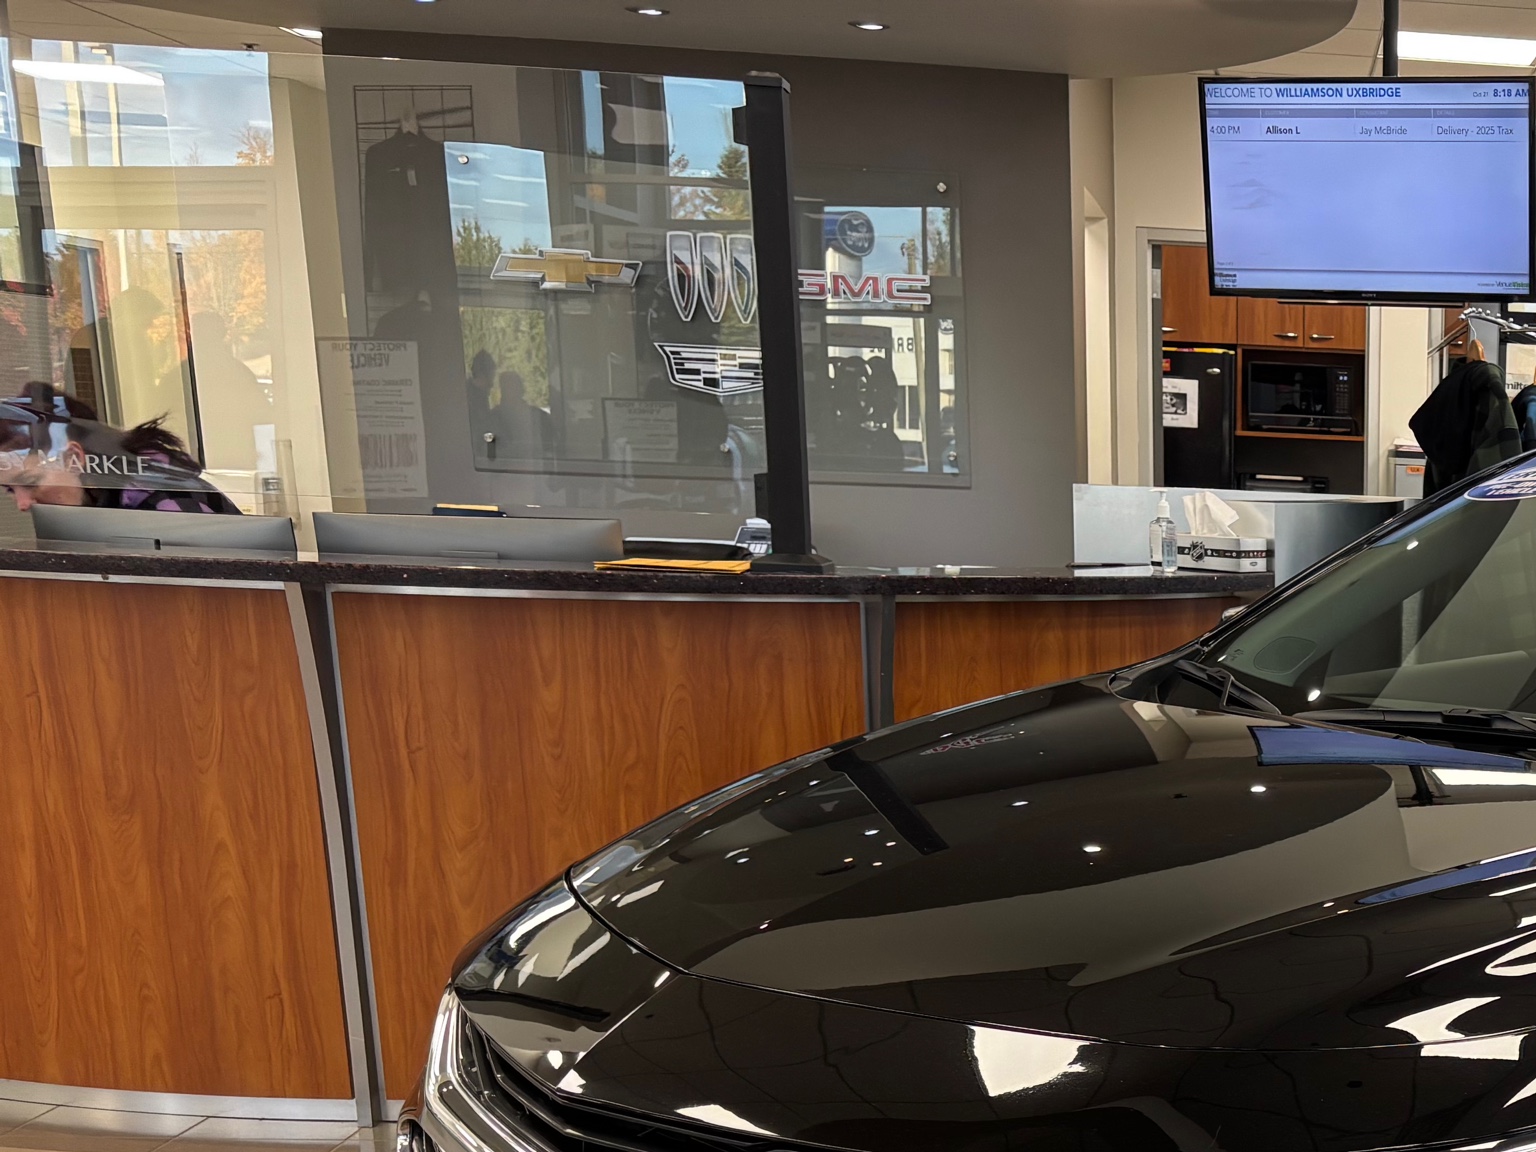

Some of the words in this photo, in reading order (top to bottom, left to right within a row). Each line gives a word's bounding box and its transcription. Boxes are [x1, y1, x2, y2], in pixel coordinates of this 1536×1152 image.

[1205, 87, 1255, 98] WELCOME
[1259, 88, 1273, 98] TO
[1275, 87, 1343, 98] WILLIAMSON
[1346, 87, 1401, 98] UXBRIDGE
[1493, 88, 1512, 98] 8:18
[1514, 88, 1529, 98] AM
[1210, 126, 1226, 135] 4:00
[1228, 126, 1241, 135] PM
[1265, 126, 1293, 135] Allison
[1295, 126, 1301, 135] L
[1359, 126, 1372, 137] Jay
[1374, 126, 1408, 135] McBride
[1437, 127, 1469, 137] Delivery
[1476, 127, 1495, 135] 2025
[1497, 127, 1514, 135] Trax
[798, 269, 932, 305] GMC
